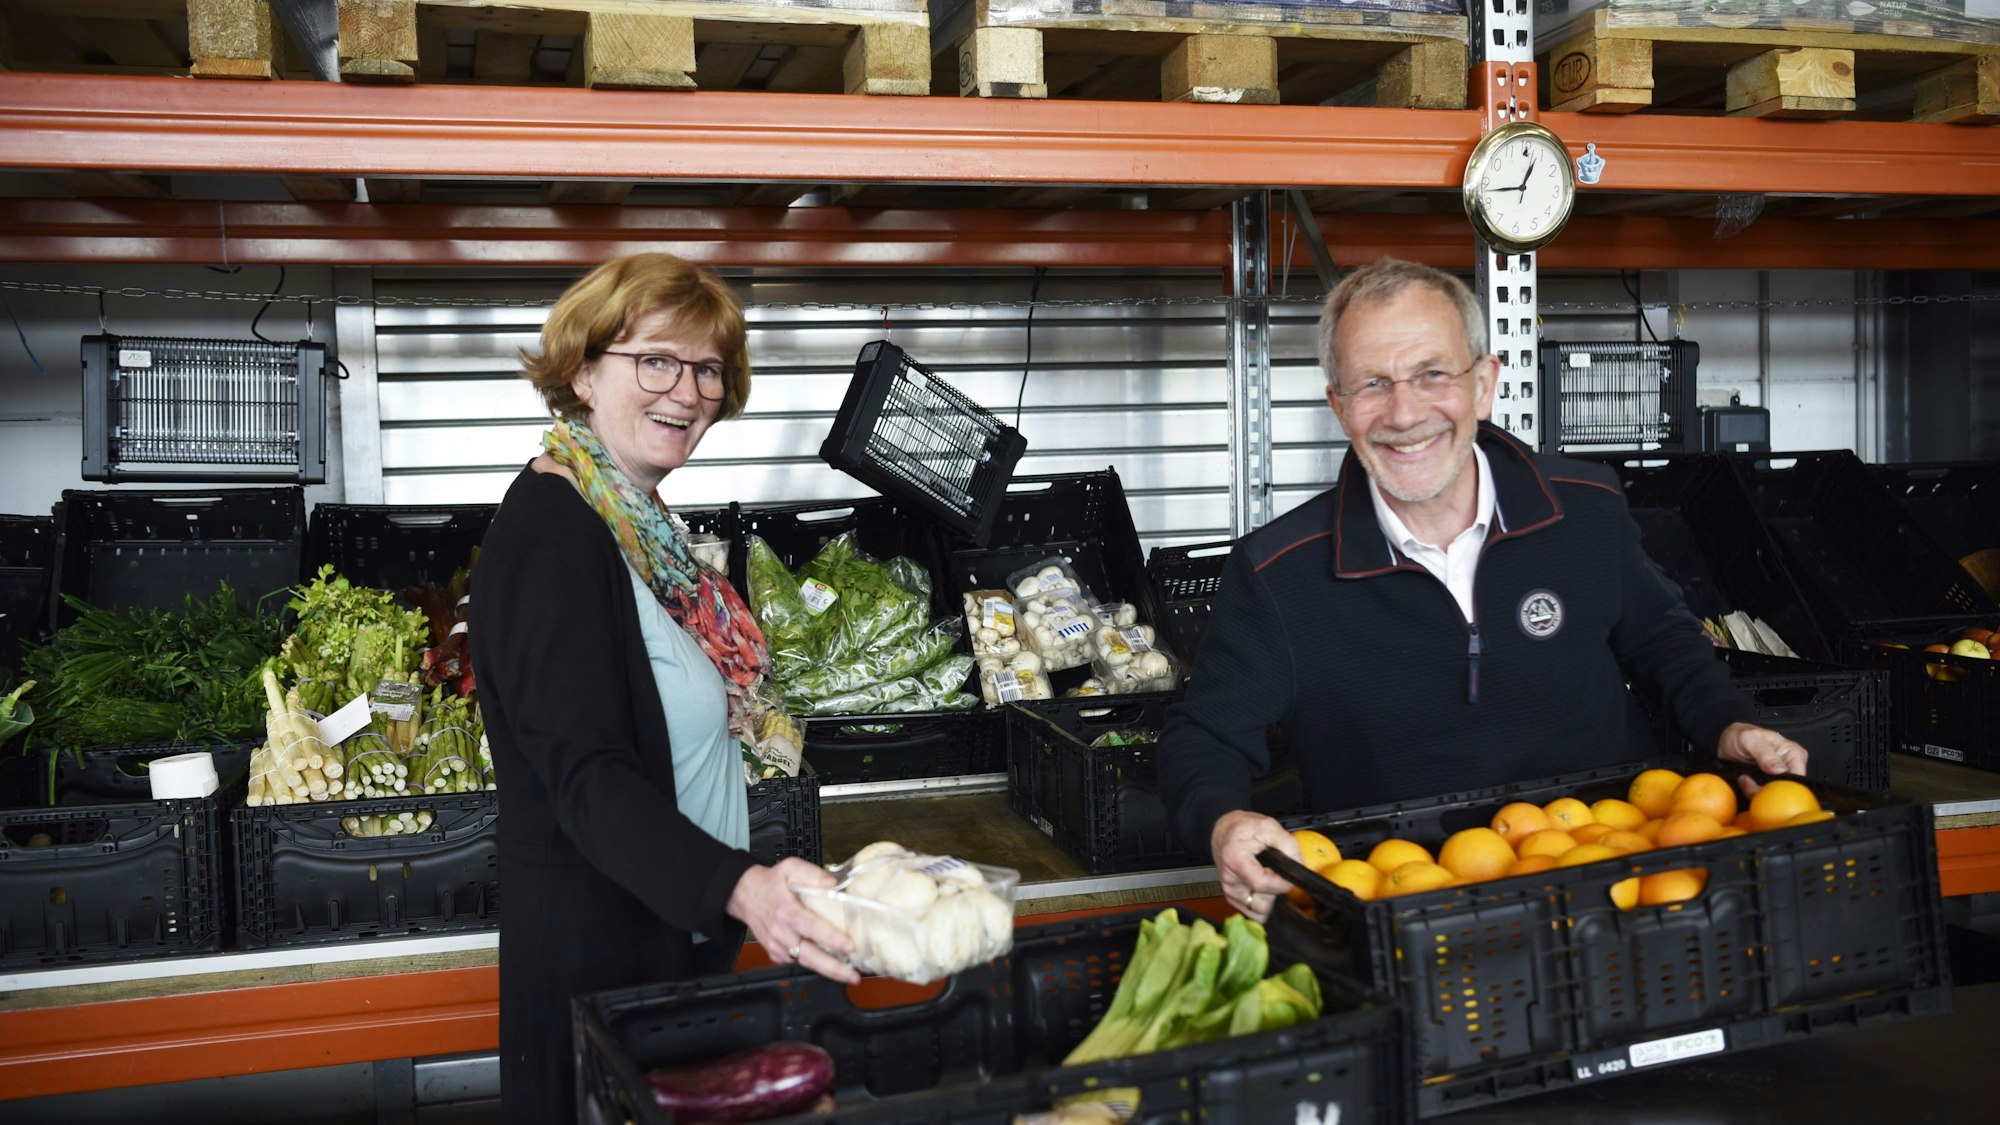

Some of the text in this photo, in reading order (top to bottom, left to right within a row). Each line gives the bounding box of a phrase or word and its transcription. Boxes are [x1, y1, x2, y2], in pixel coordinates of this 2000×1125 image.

[1879, 1, 1907, 9] NATUR
[1561, 58, 1584, 86] EUR
[1504, 144, 1514, 159] 11
[1490, 157, 1502, 172] 10
[1548, 164, 1557, 178] 2
[1551, 185, 1560, 199] 3
[1484, 196, 1492, 211] 8
[1544, 204, 1552, 217] 4
[1496, 212, 1504, 226] 7
[1530, 217, 1538, 231] 5
[1511, 221, 1520, 234] 6
[763, 753, 792, 768] ARGEL
[1672, 1037, 1703, 1051] IFCO
